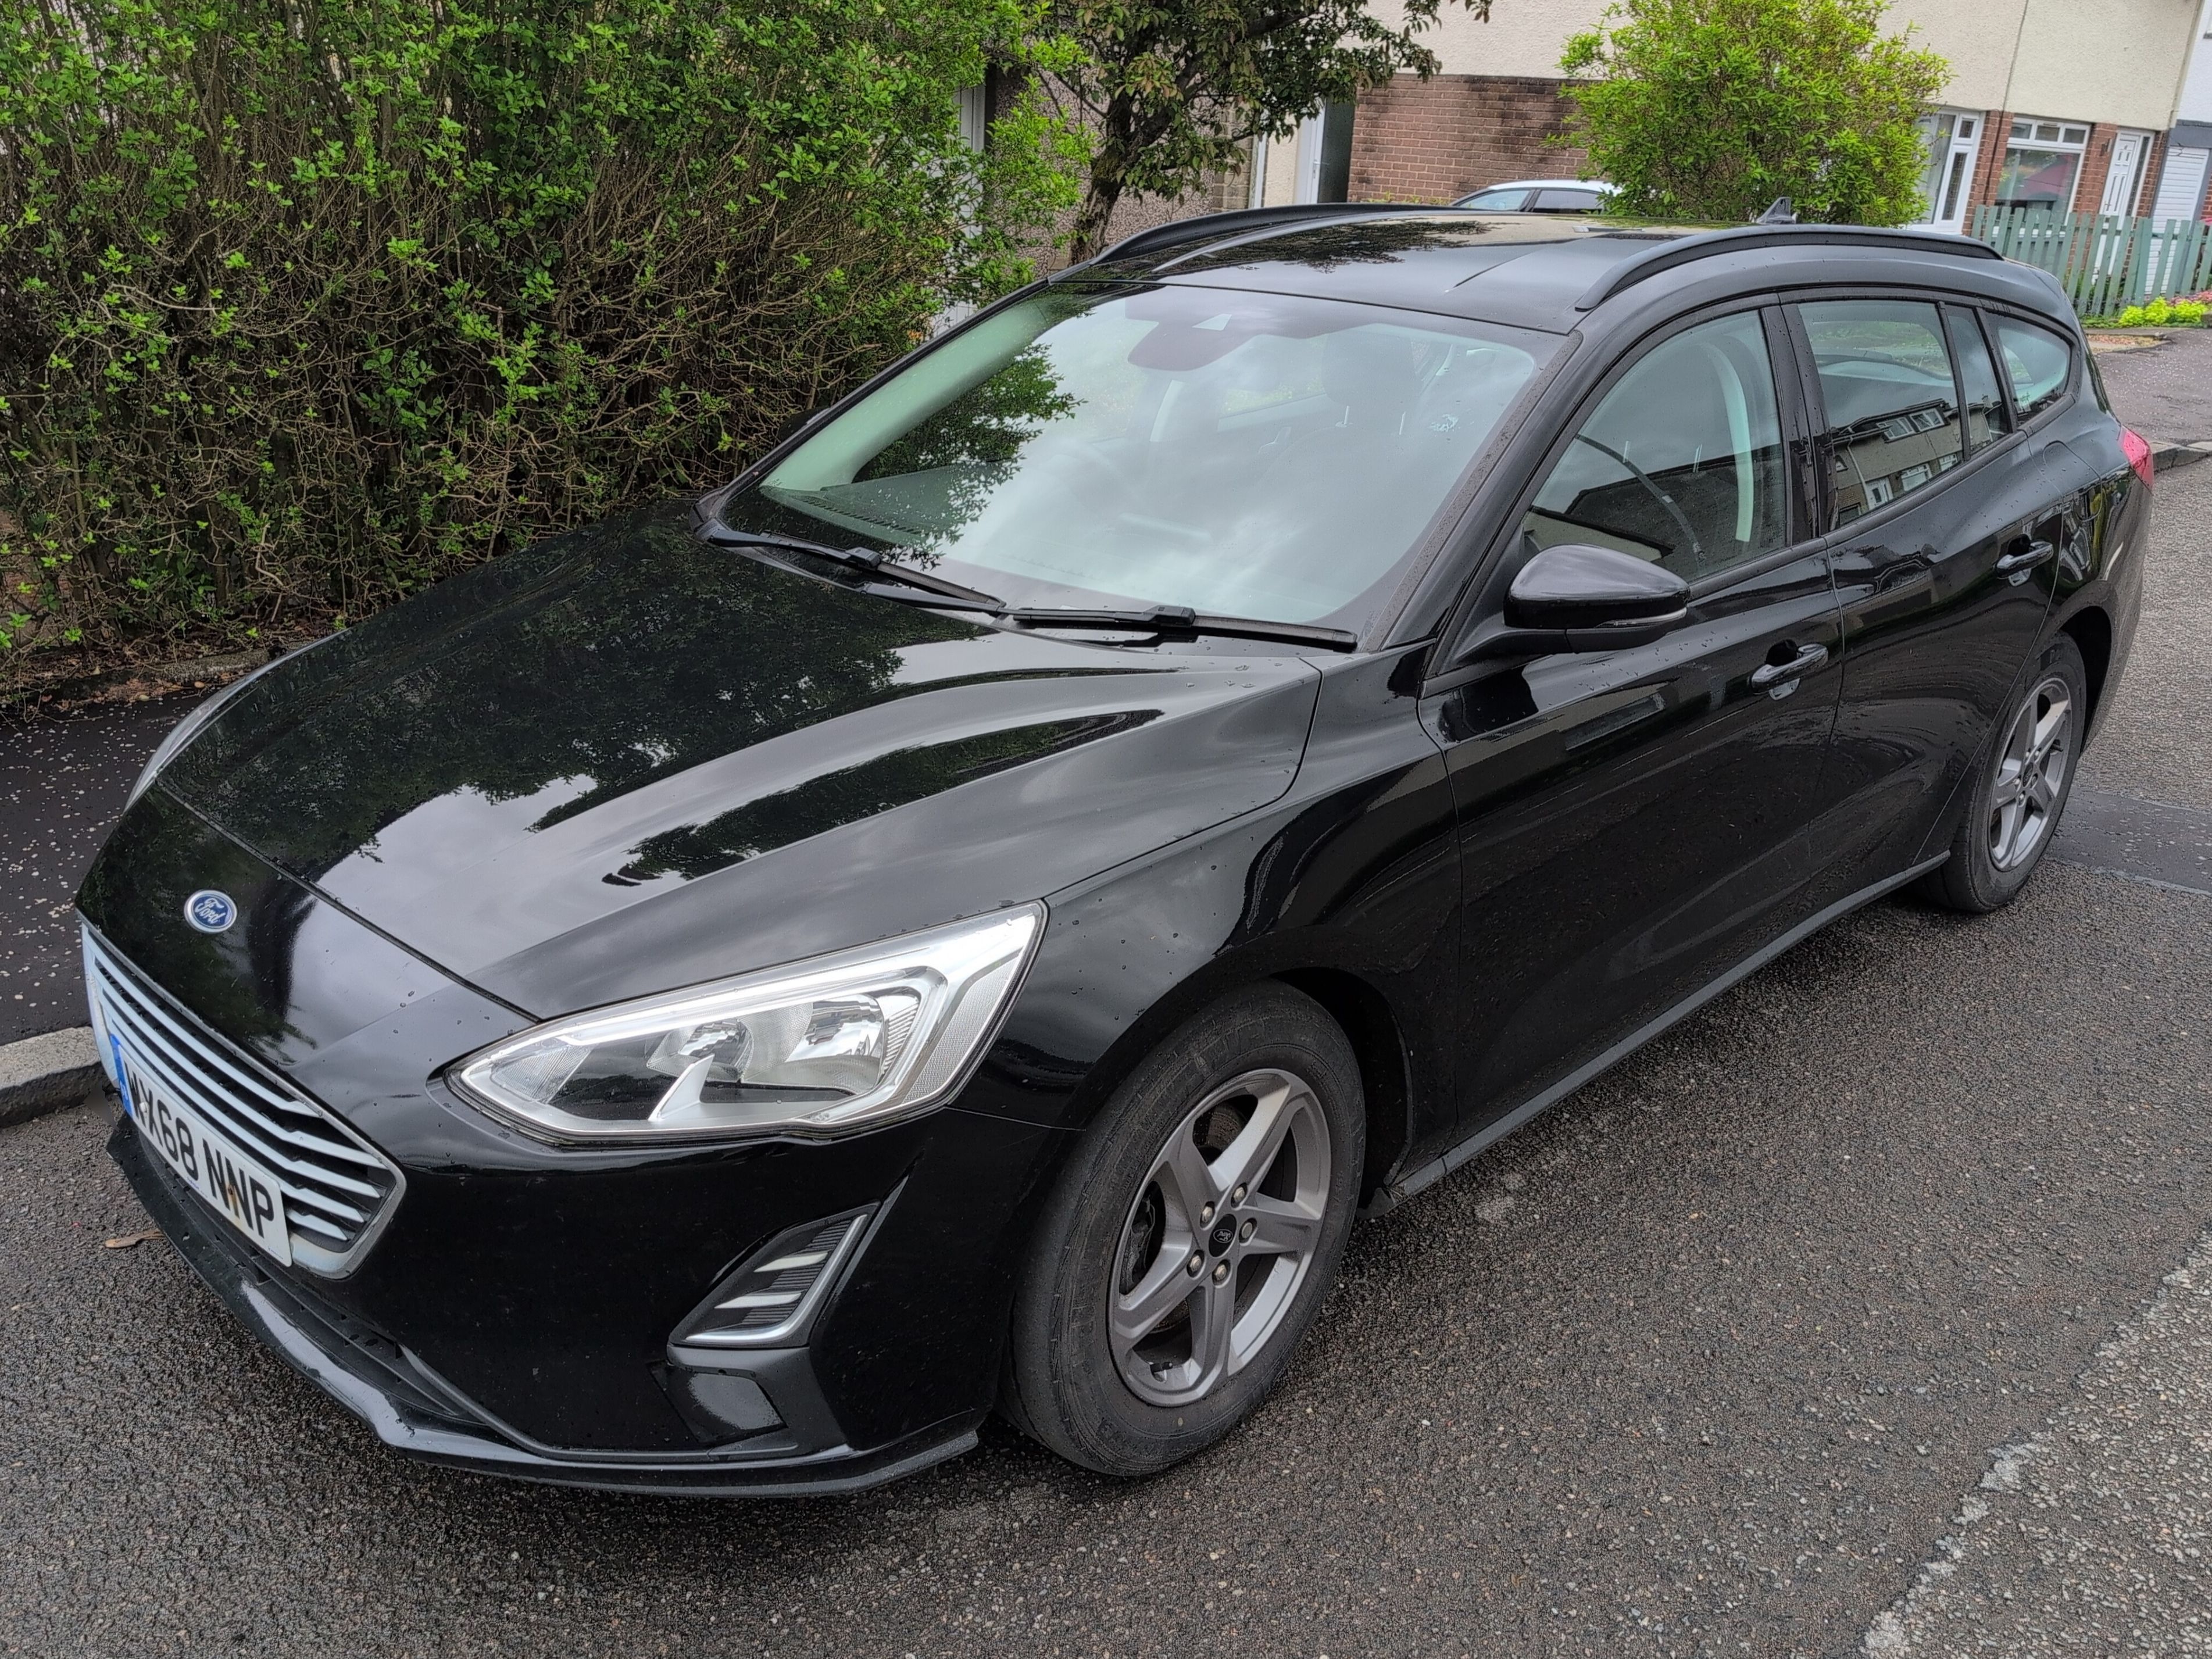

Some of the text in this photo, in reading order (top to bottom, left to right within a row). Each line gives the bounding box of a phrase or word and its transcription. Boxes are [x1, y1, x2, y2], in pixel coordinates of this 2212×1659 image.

[195, 898, 226, 924] Ford
[124, 1060, 274, 1239] WX68 NNP
